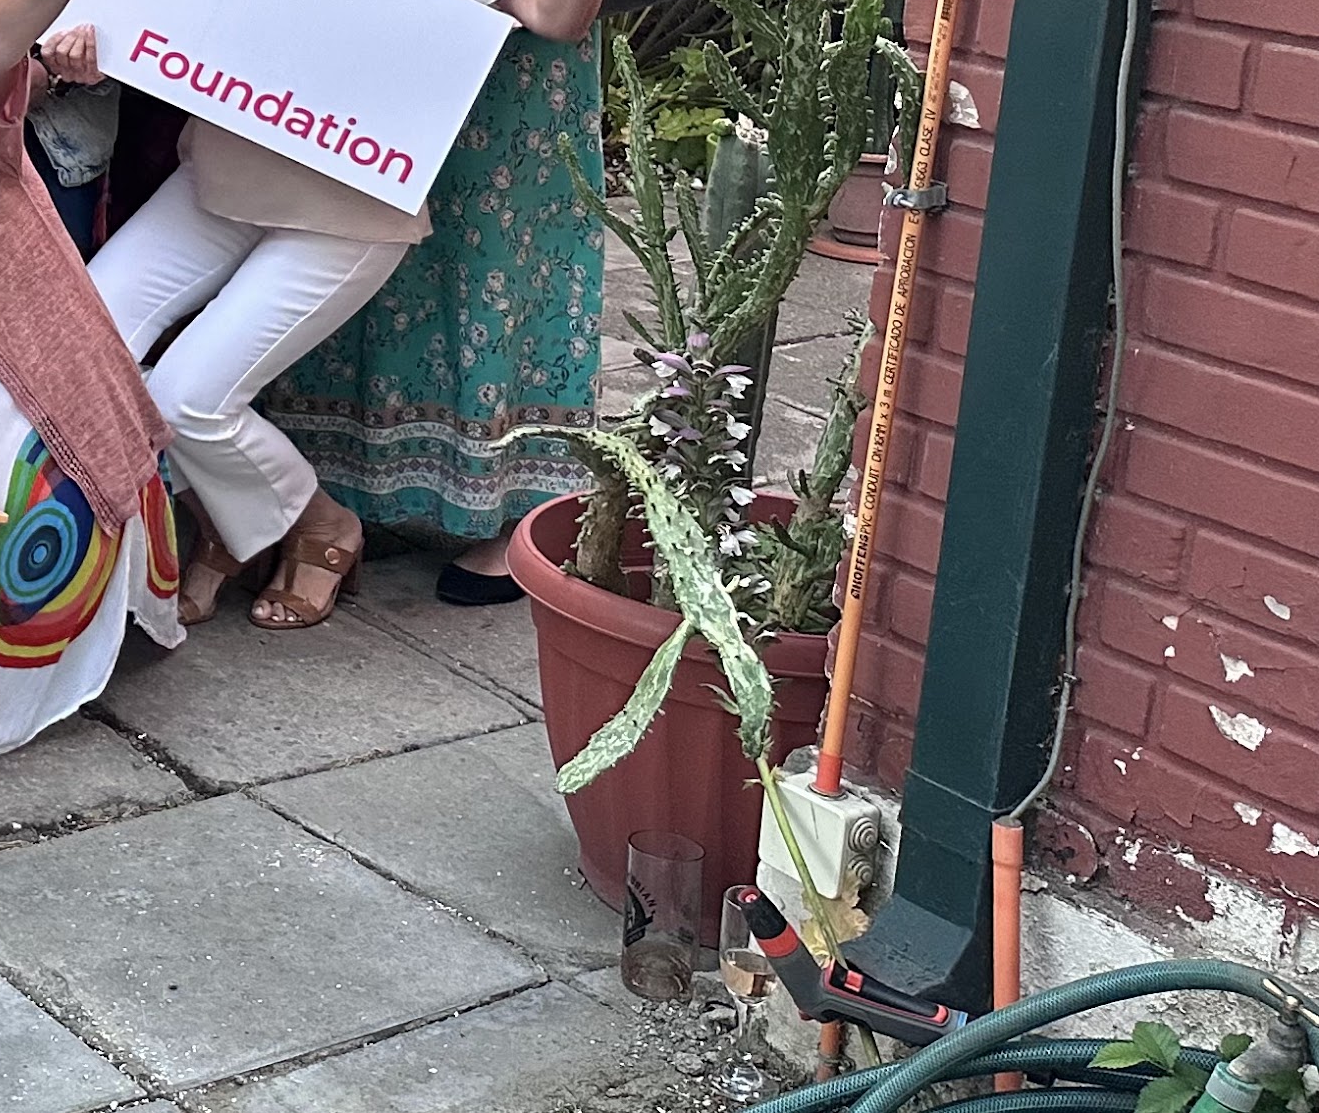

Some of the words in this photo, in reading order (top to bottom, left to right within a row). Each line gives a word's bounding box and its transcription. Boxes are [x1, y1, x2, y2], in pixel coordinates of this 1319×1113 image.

[128, 27, 415, 185] Foundation
[924, 107, 936, 120] IV
[918, 124, 934, 156] CLASE
[896, 233, 916, 298] APROBACION
[893, 302, 905, 316] DE
[883, 319, 903, 385] CERTIFICADO
[879, 400, 890, 409] 3
[883, 389, 892, 397] m
[863, 464, 880, 510] CONDUIT
[860, 512, 873, 534] PVC
[851, 533, 869, 591] HOFFENS
